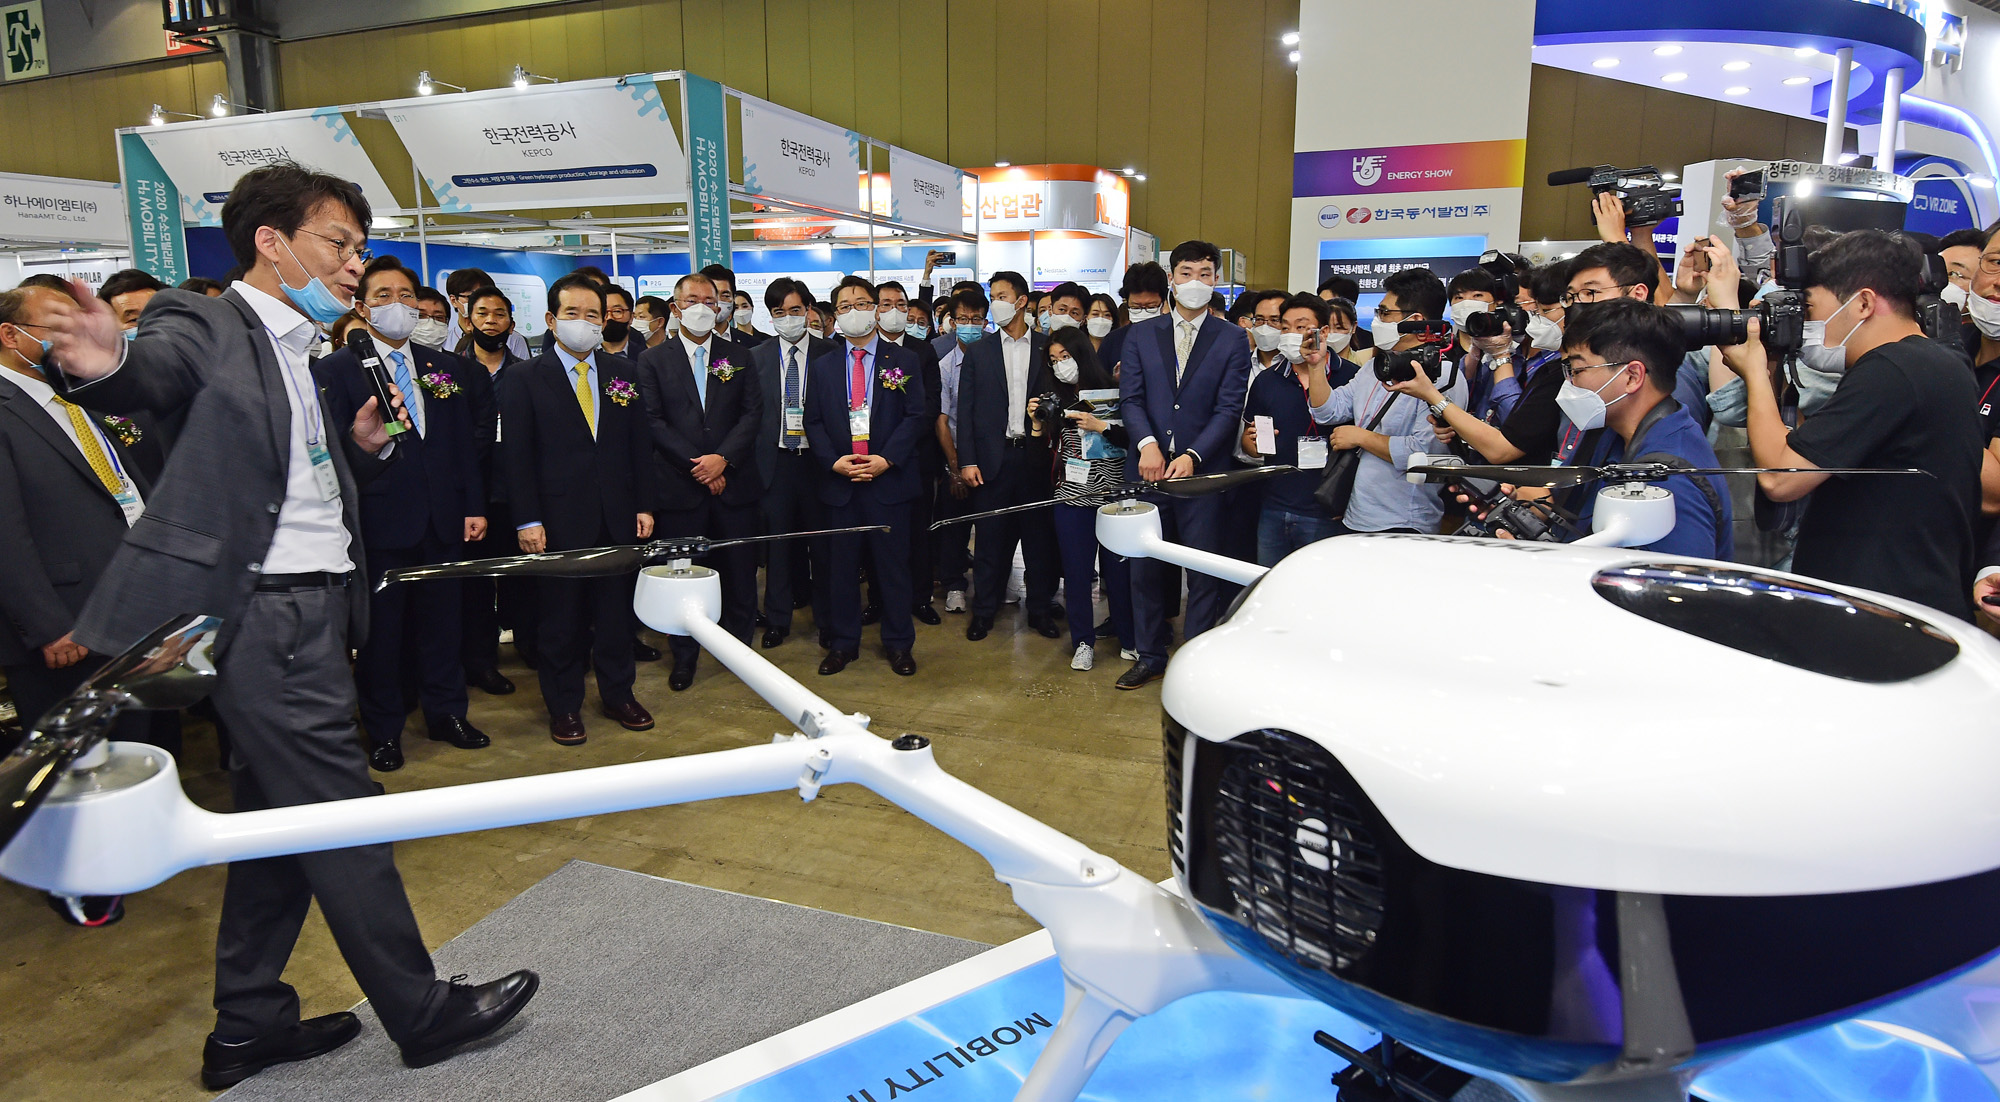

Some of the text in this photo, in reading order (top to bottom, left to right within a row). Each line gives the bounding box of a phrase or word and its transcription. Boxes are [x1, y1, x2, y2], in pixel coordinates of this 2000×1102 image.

[481, 120, 578, 145] 한국전력공사
[521, 148, 553, 158] KEPCO
[707, 140, 718, 177] 2020
[781, 138, 831, 168] 한국전력공사
[798, 165, 816, 177] KEPCO
[1387, 170, 1423, 181] ENERGY
[1424, 168, 1453, 178] SHOW
[1769, 162, 1801, 179] 정부의
[154, 181, 168, 211] 2020
[913, 177, 945, 200] 한국전력공사
[3, 194, 97, 214] 하나에이엠티(주)
[17, 211, 55, 220] HanaAMT
[697, 159, 712, 256] MOBILITY+
[980, 192, 1042, 219] 산업관
[1929, 197, 1958, 214] VR ZONE
[139, 196, 160, 273] MOBILITY+
[884, 1012, 1054, 1100] MOBILITY
